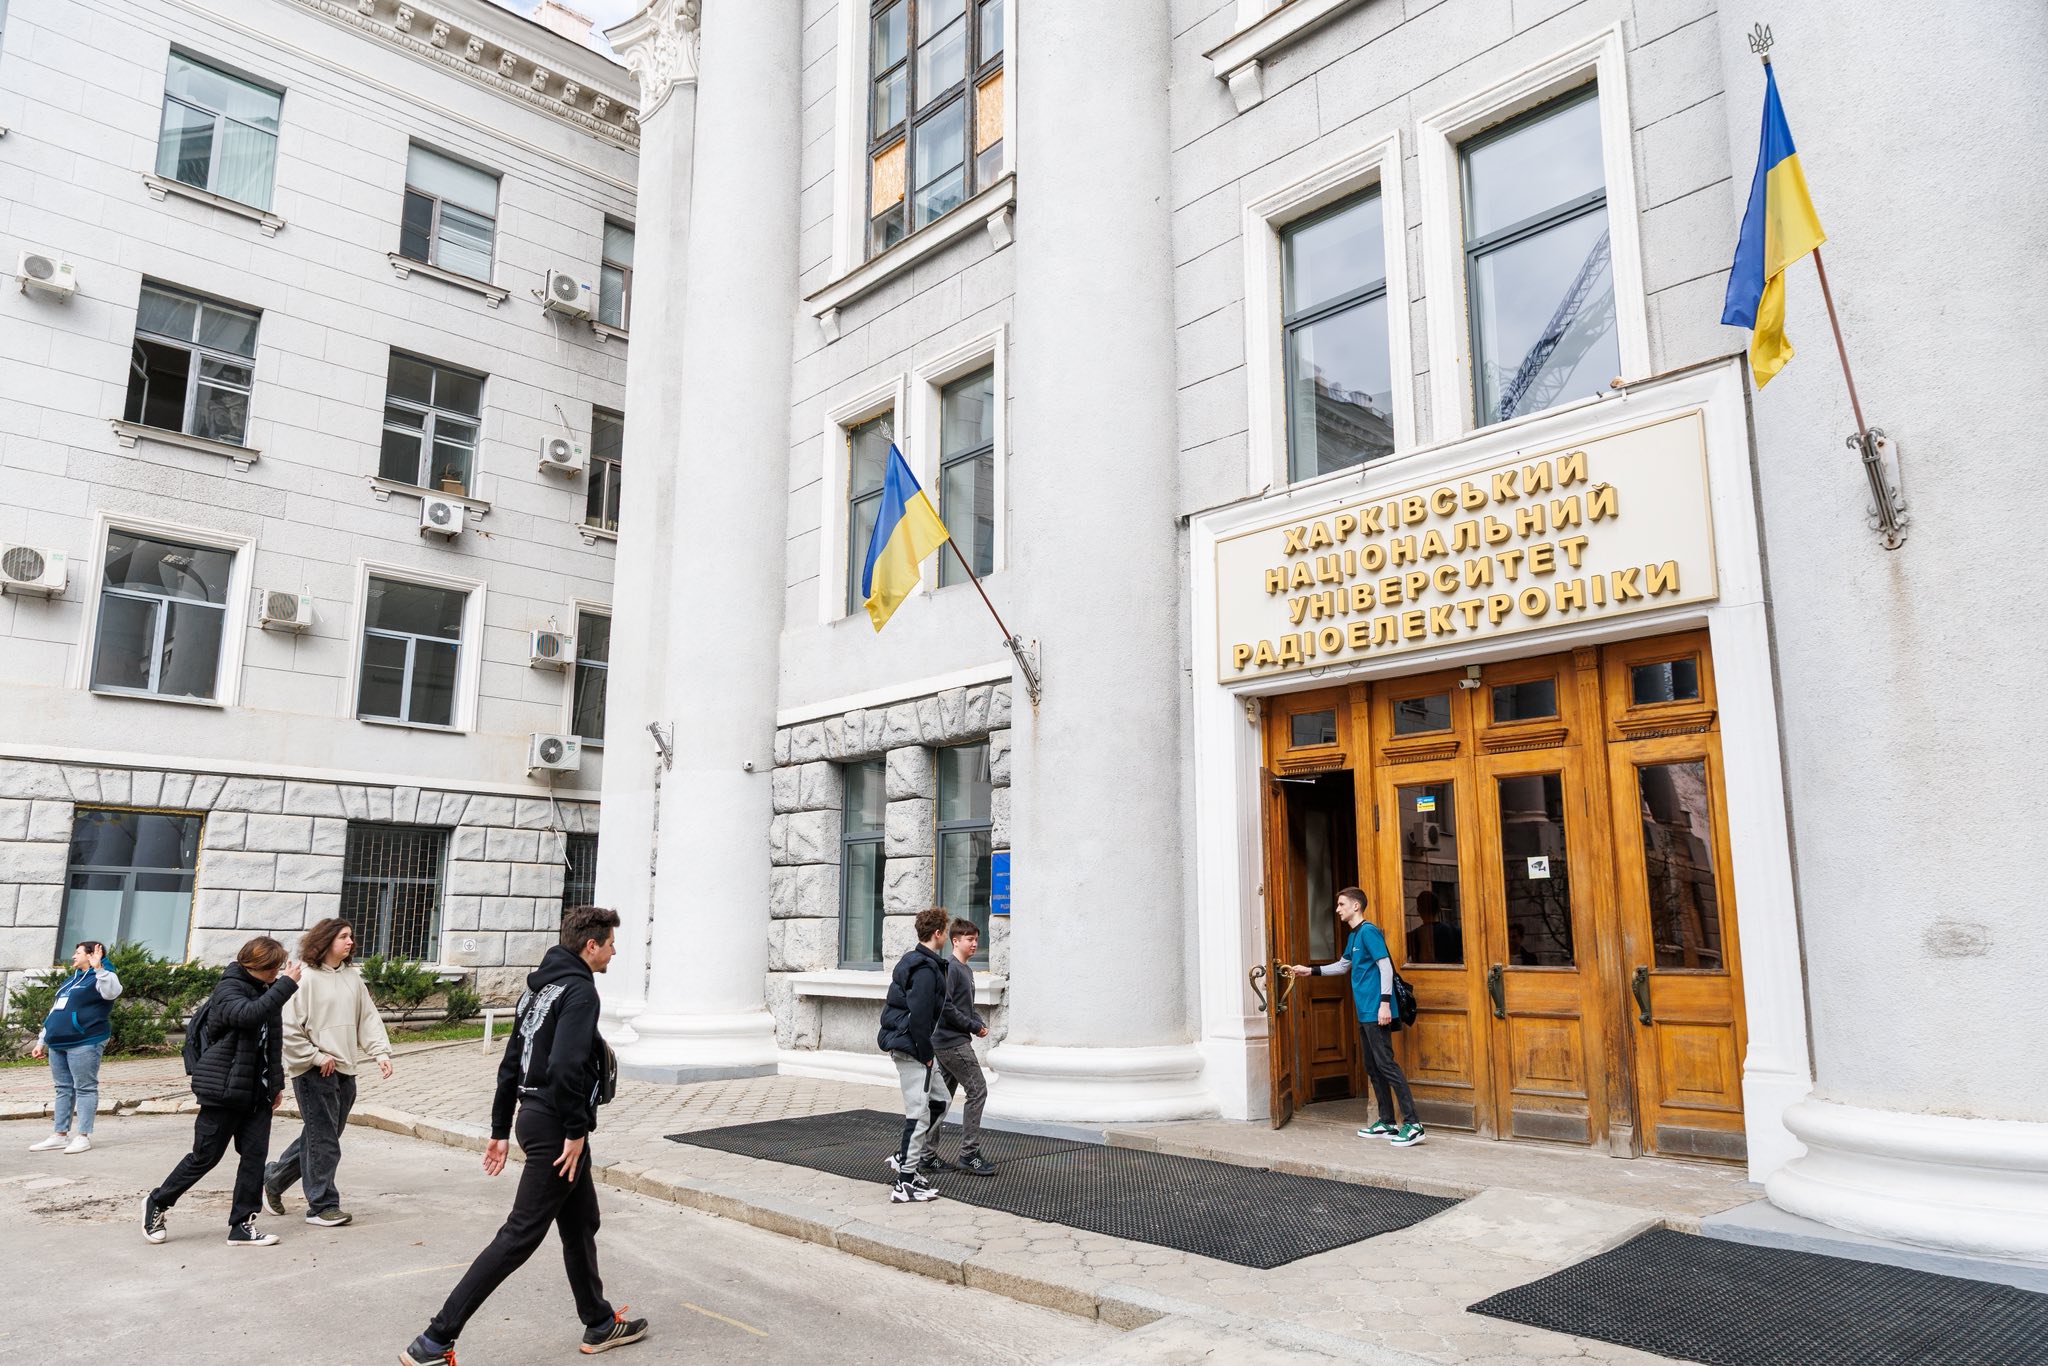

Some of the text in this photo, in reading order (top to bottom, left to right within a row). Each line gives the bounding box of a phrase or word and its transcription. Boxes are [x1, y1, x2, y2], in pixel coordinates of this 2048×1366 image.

[1265, 482, 1618, 594] НАЦІОНАЛЬНИЙ
[1283, 451, 1588, 556] ХАРКІВСЬКИЙ
[1233, 560, 1681, 670] РАДІОЕЛЕКТРОНІКИ
[1288, 535, 1588, 624] УНІВЕРСИТЕТ
